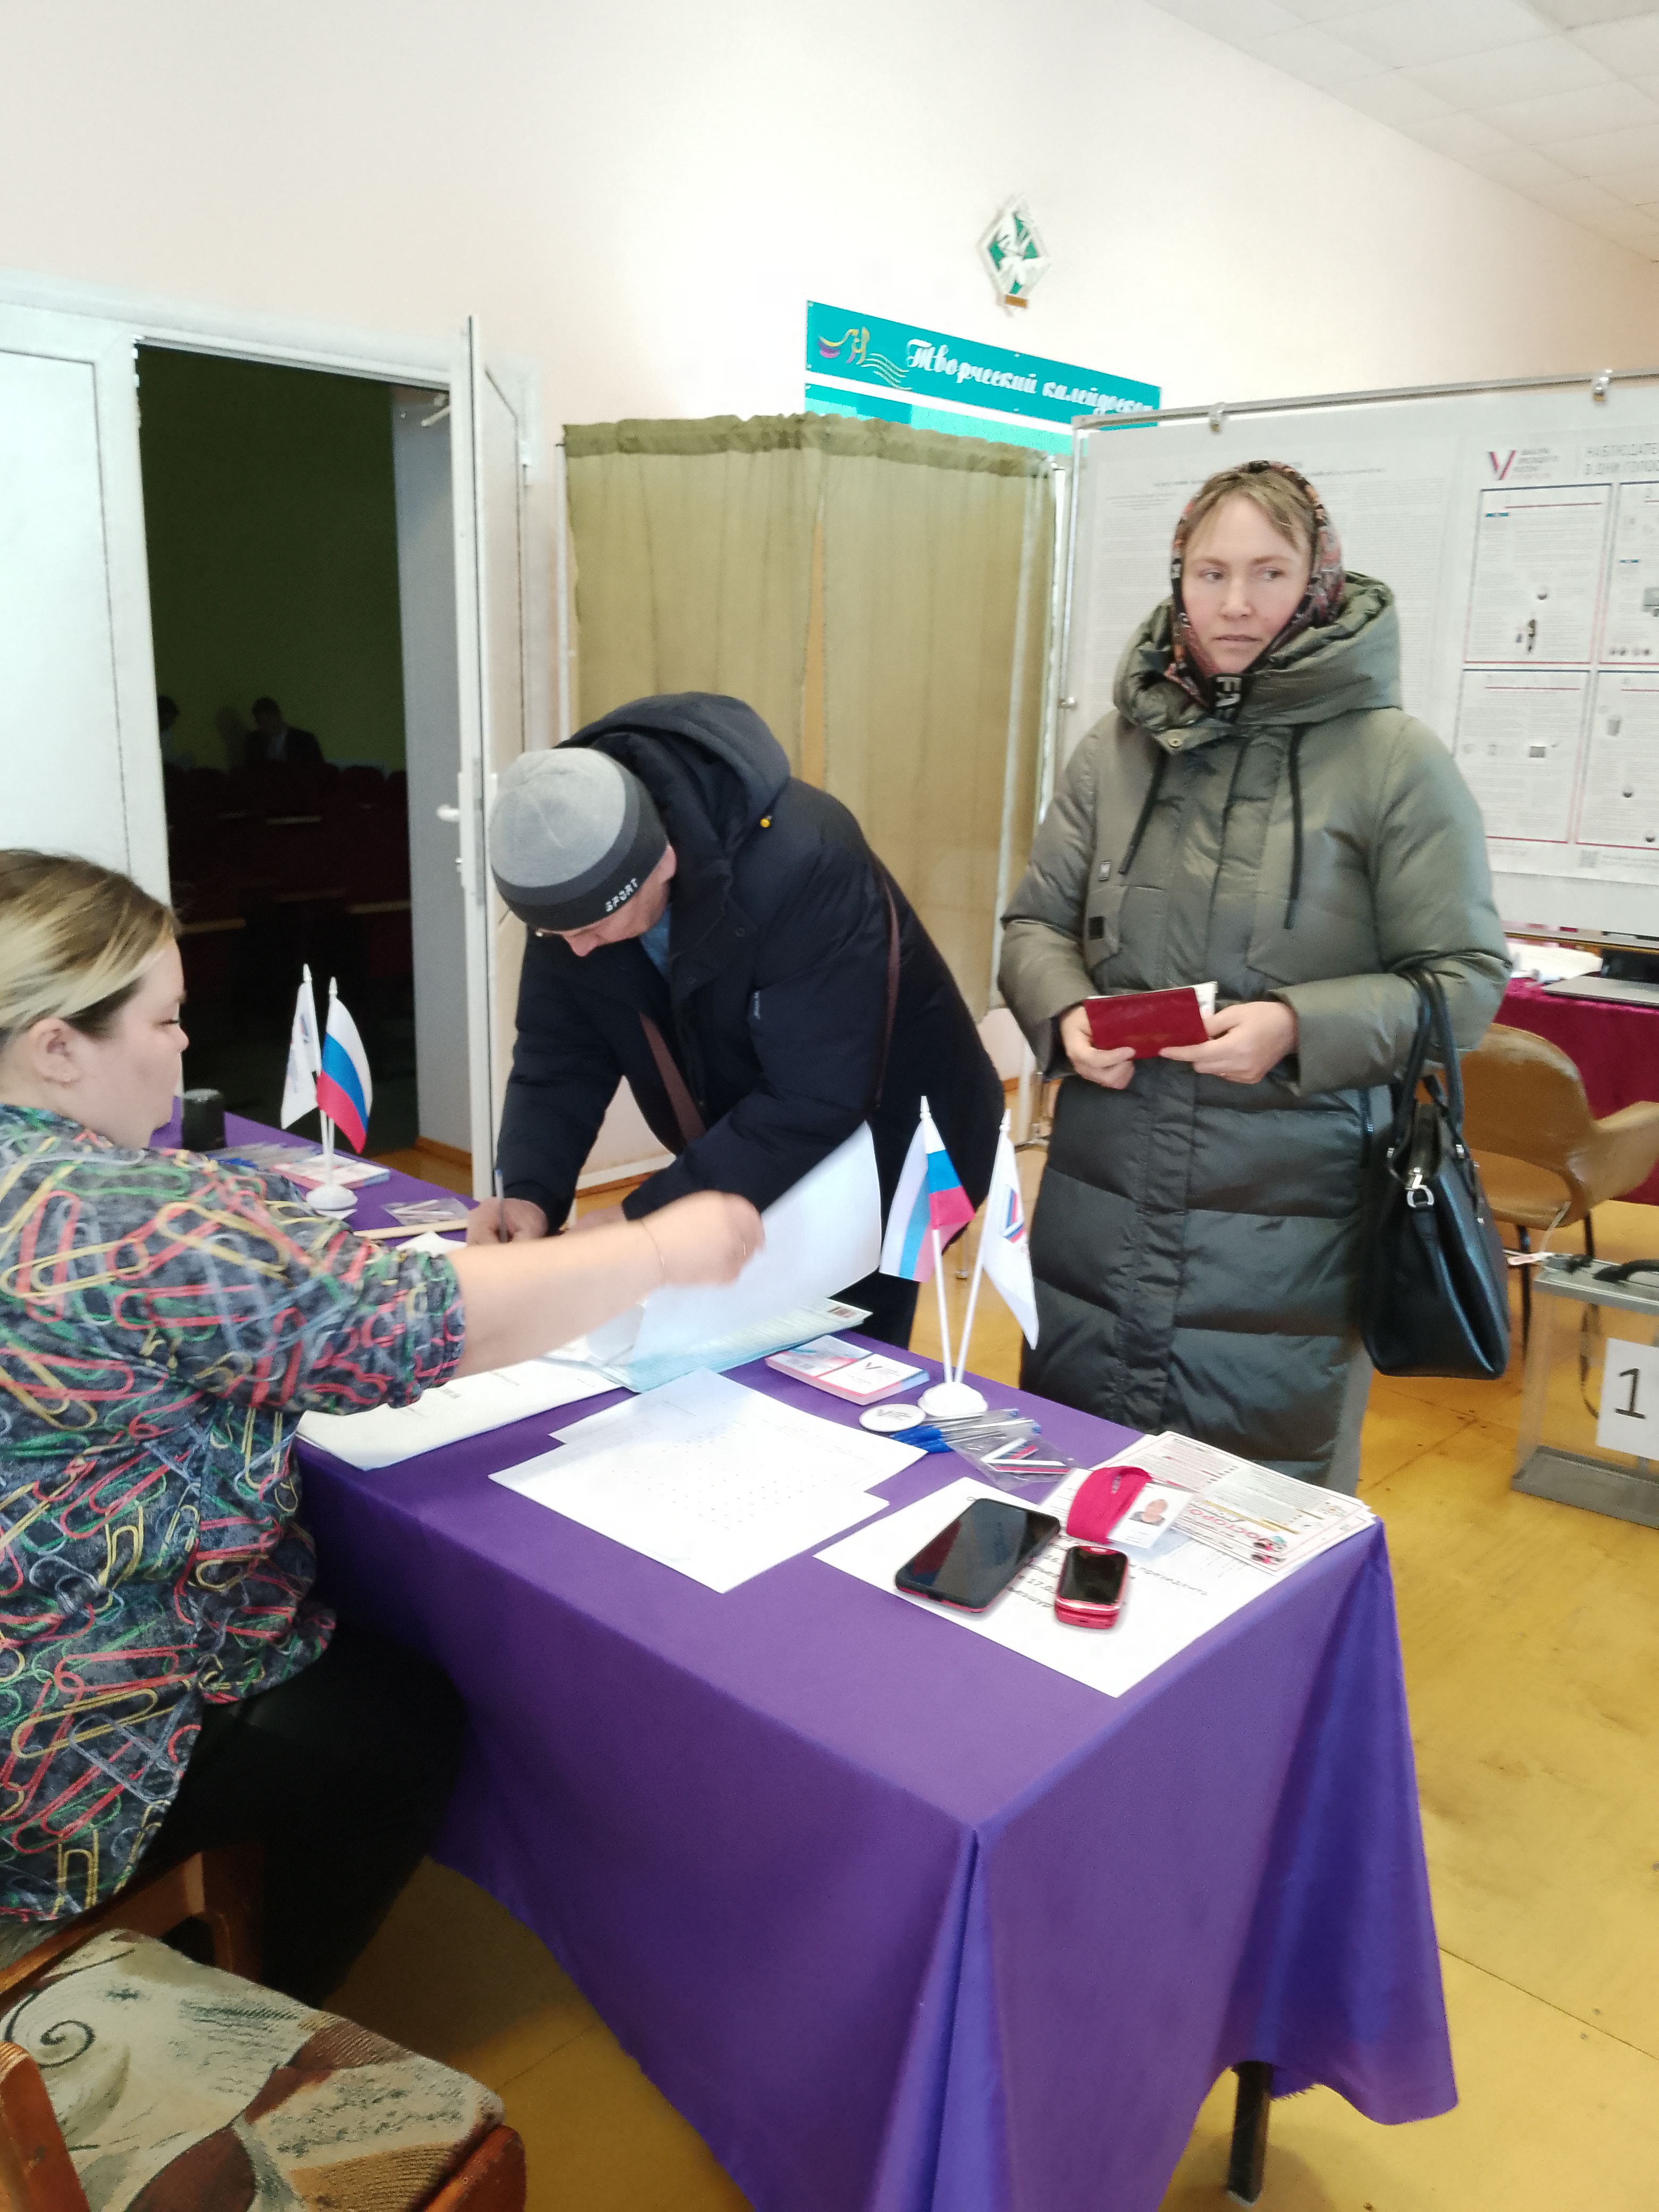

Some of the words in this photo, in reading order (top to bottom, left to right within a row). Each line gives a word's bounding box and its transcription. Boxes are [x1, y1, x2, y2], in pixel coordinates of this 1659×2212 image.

[906, 339, 1037, 394] Творческий
[605, 877, 638, 912] SPORT
[1614, 1367, 1647, 1420] 1
